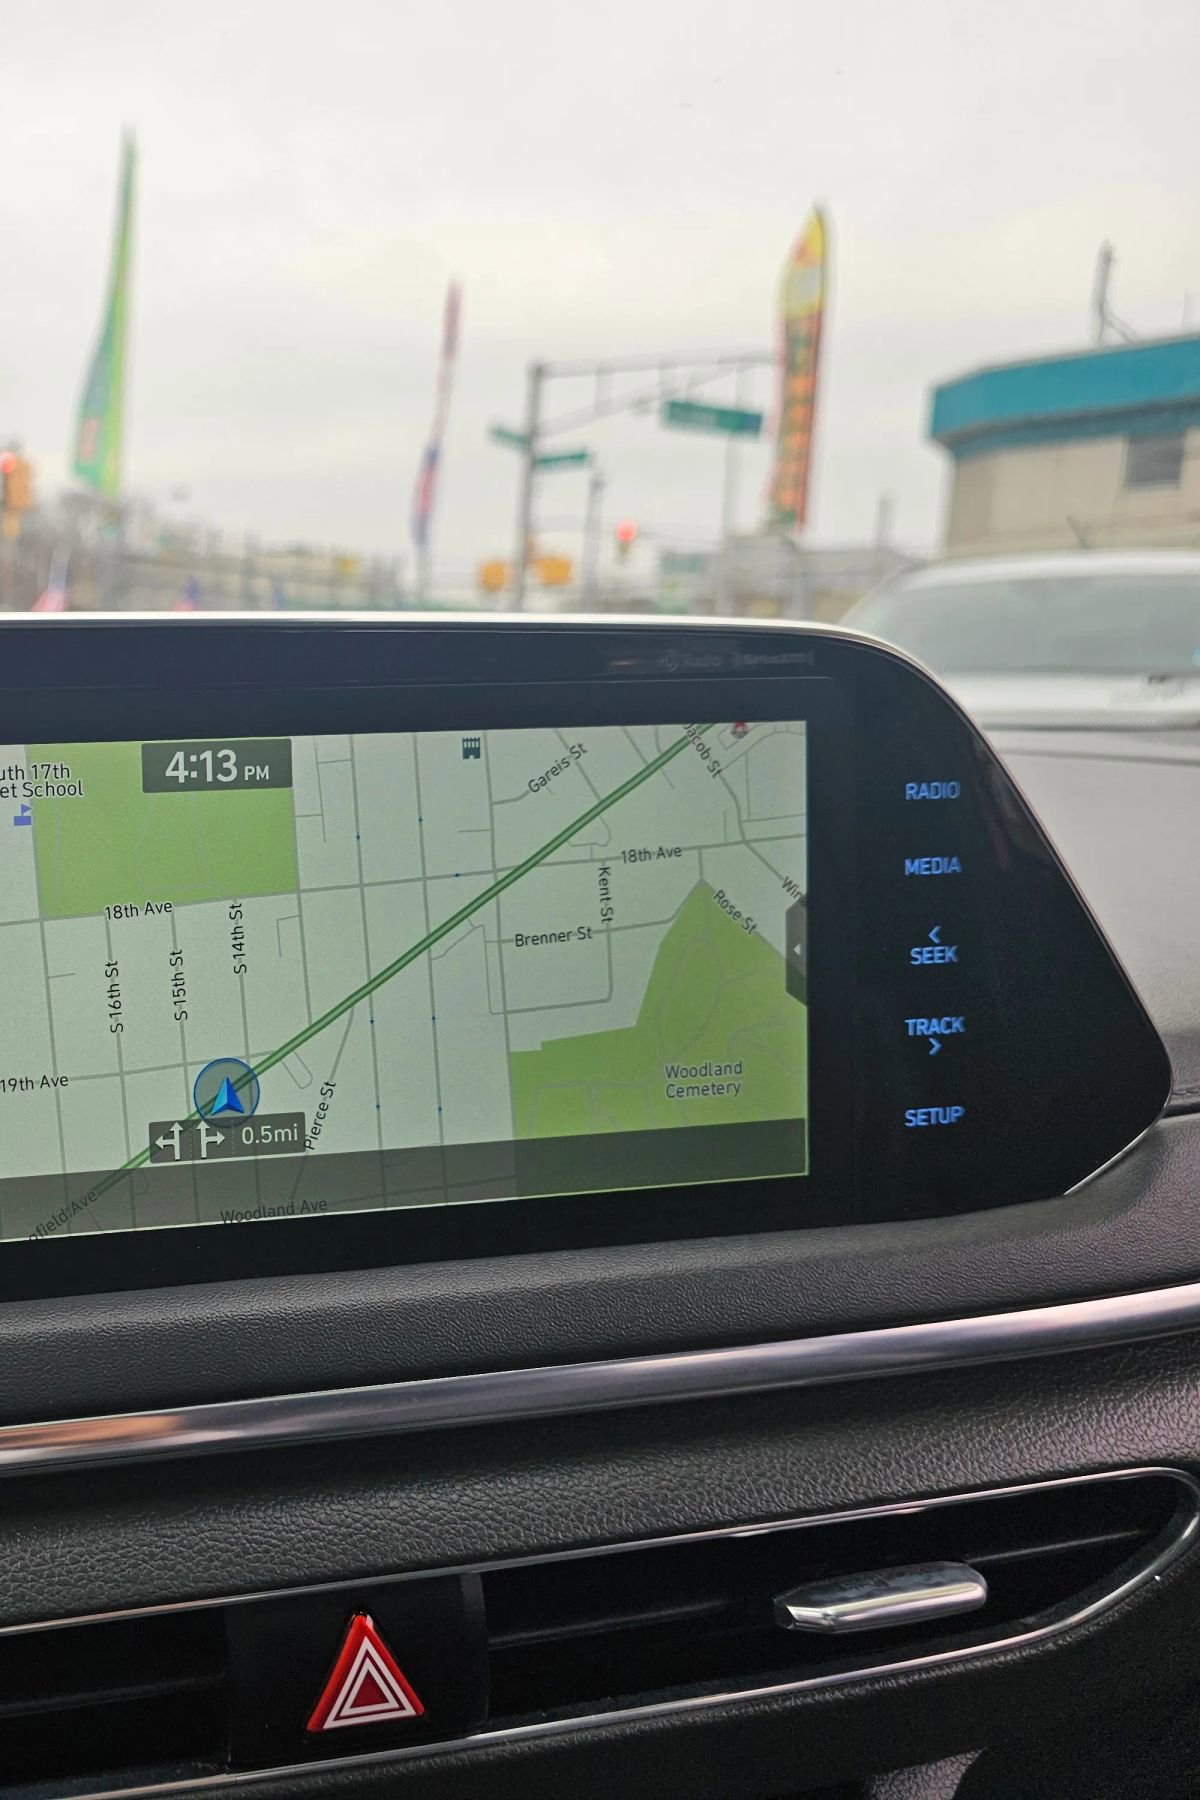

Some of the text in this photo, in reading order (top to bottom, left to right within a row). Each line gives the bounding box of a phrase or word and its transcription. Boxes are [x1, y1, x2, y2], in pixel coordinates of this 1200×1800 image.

[31, 763, 71, 780] 17th
[165, 749, 270, 784] 4:13 PM
[527, 742, 588, 793] Gareis St
[706, 760, 723, 779] St
[22, 780, 84, 798] School
[905, 781, 961, 800] RADIO
[621, 846, 683, 864] 18th Ave
[904, 856, 962, 876] MEDIA
[598, 866, 615, 923] Kent St
[104, 901, 173, 920] 18th Ave
[712, 889, 758, 936] Rose St
[229, 903, 247, 975] S 14th St
[515, 926, 593, 948] Brenner St
[910, 944, 959, 966] SEEK
[170, 949, 188, 1021] S 15th St
[105, 960, 124, 1033] S 16th St
[905, 1016, 966, 1037] TRACK
[665, 1060, 743, 1078] Woodland
[0, 1074, 70, 1093] 19th Ave
[666, 1082, 742, 1099] Cemetery
[303, 1080, 337, 1151] Pierce St
[904, 1106, 965, 1128] SETUP
[241, 1123, 299, 1146] 0.5mi
[220, 1198, 328, 1224] Woodland Ave
